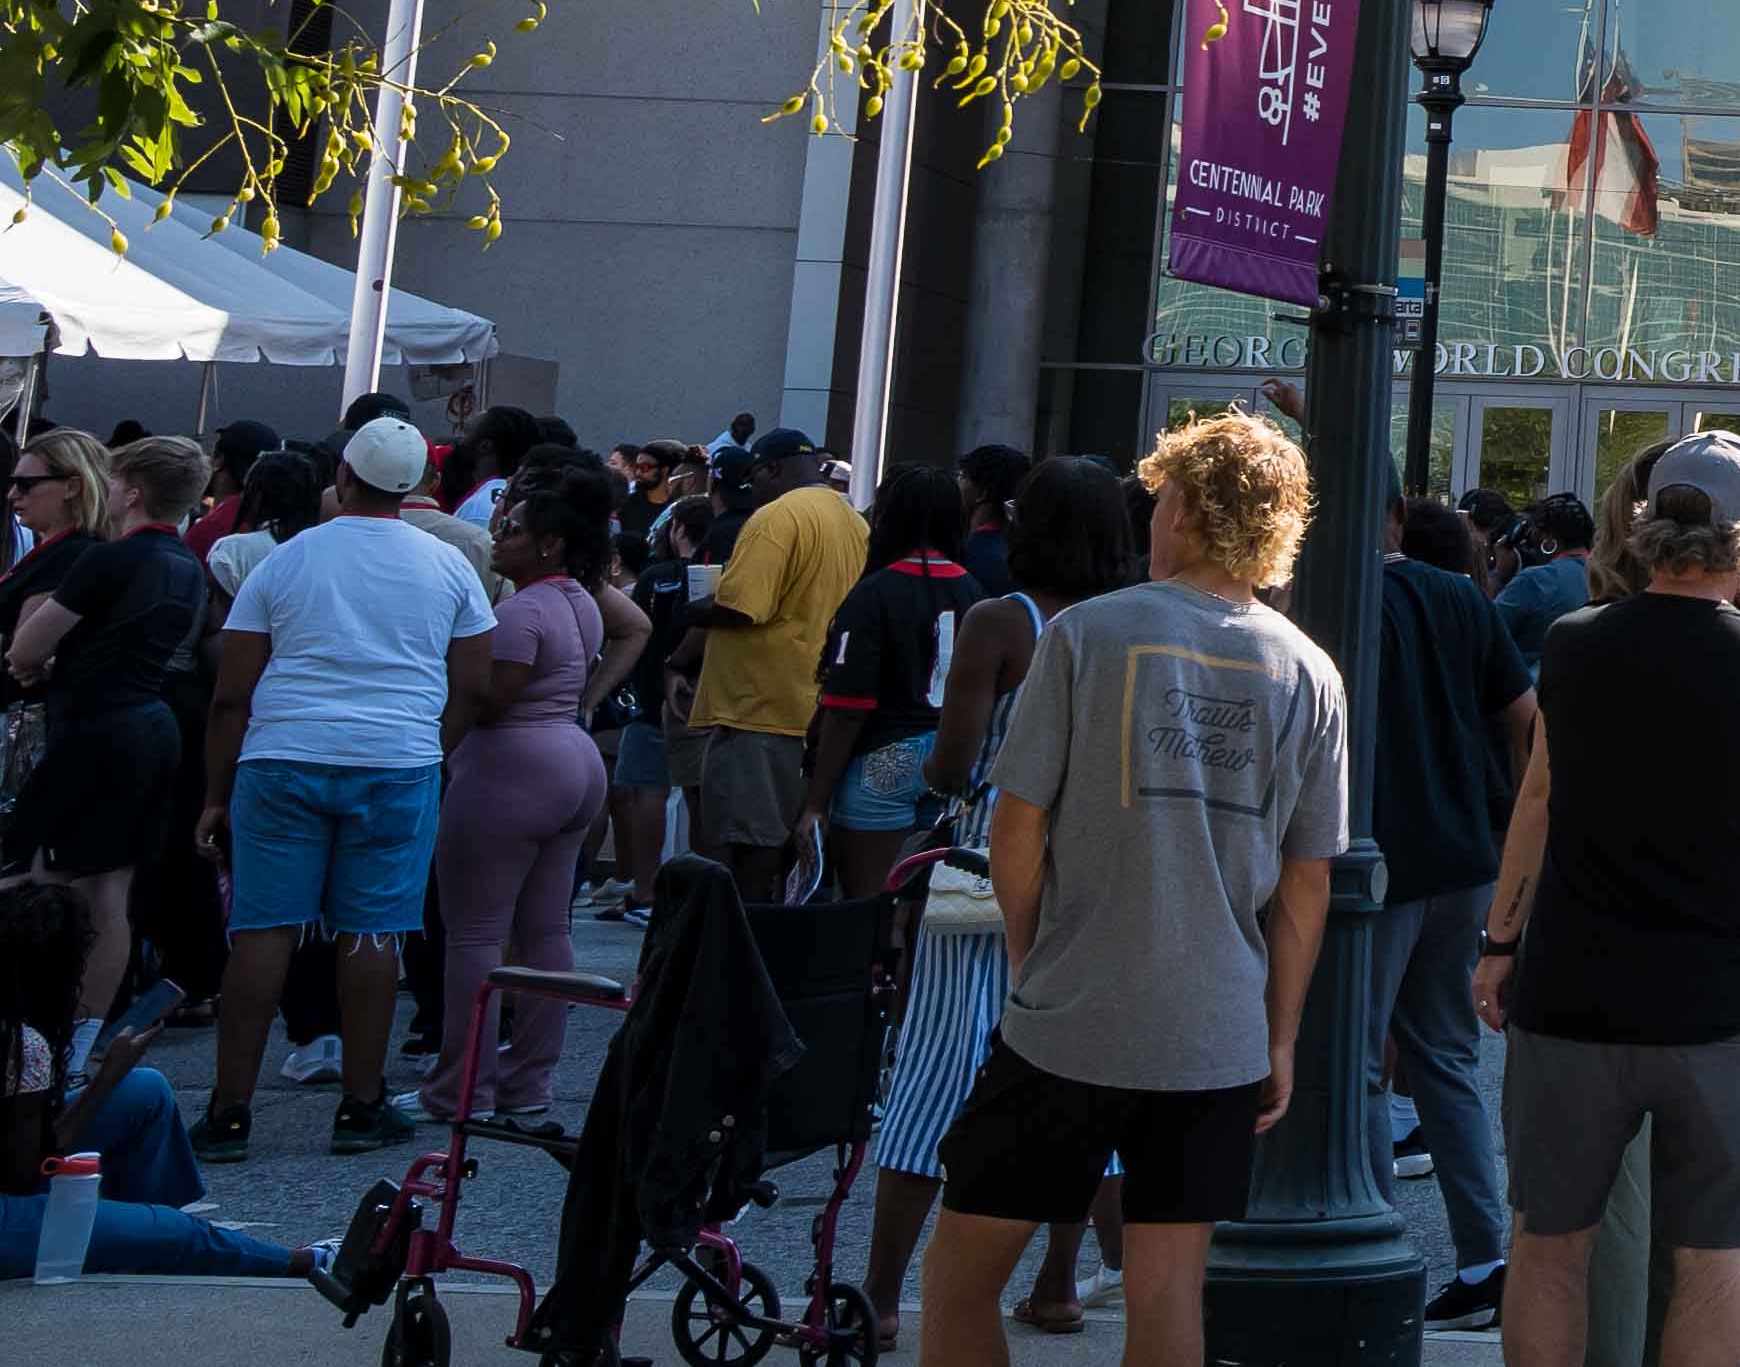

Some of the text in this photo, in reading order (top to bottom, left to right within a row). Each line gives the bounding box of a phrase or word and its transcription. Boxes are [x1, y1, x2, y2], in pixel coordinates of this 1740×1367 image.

[1189, 159, 1325, 217] CENTENNIAL PARK
[1395, 297, 1422, 315] arta
[1142, 332, 1308, 369] GEORG
